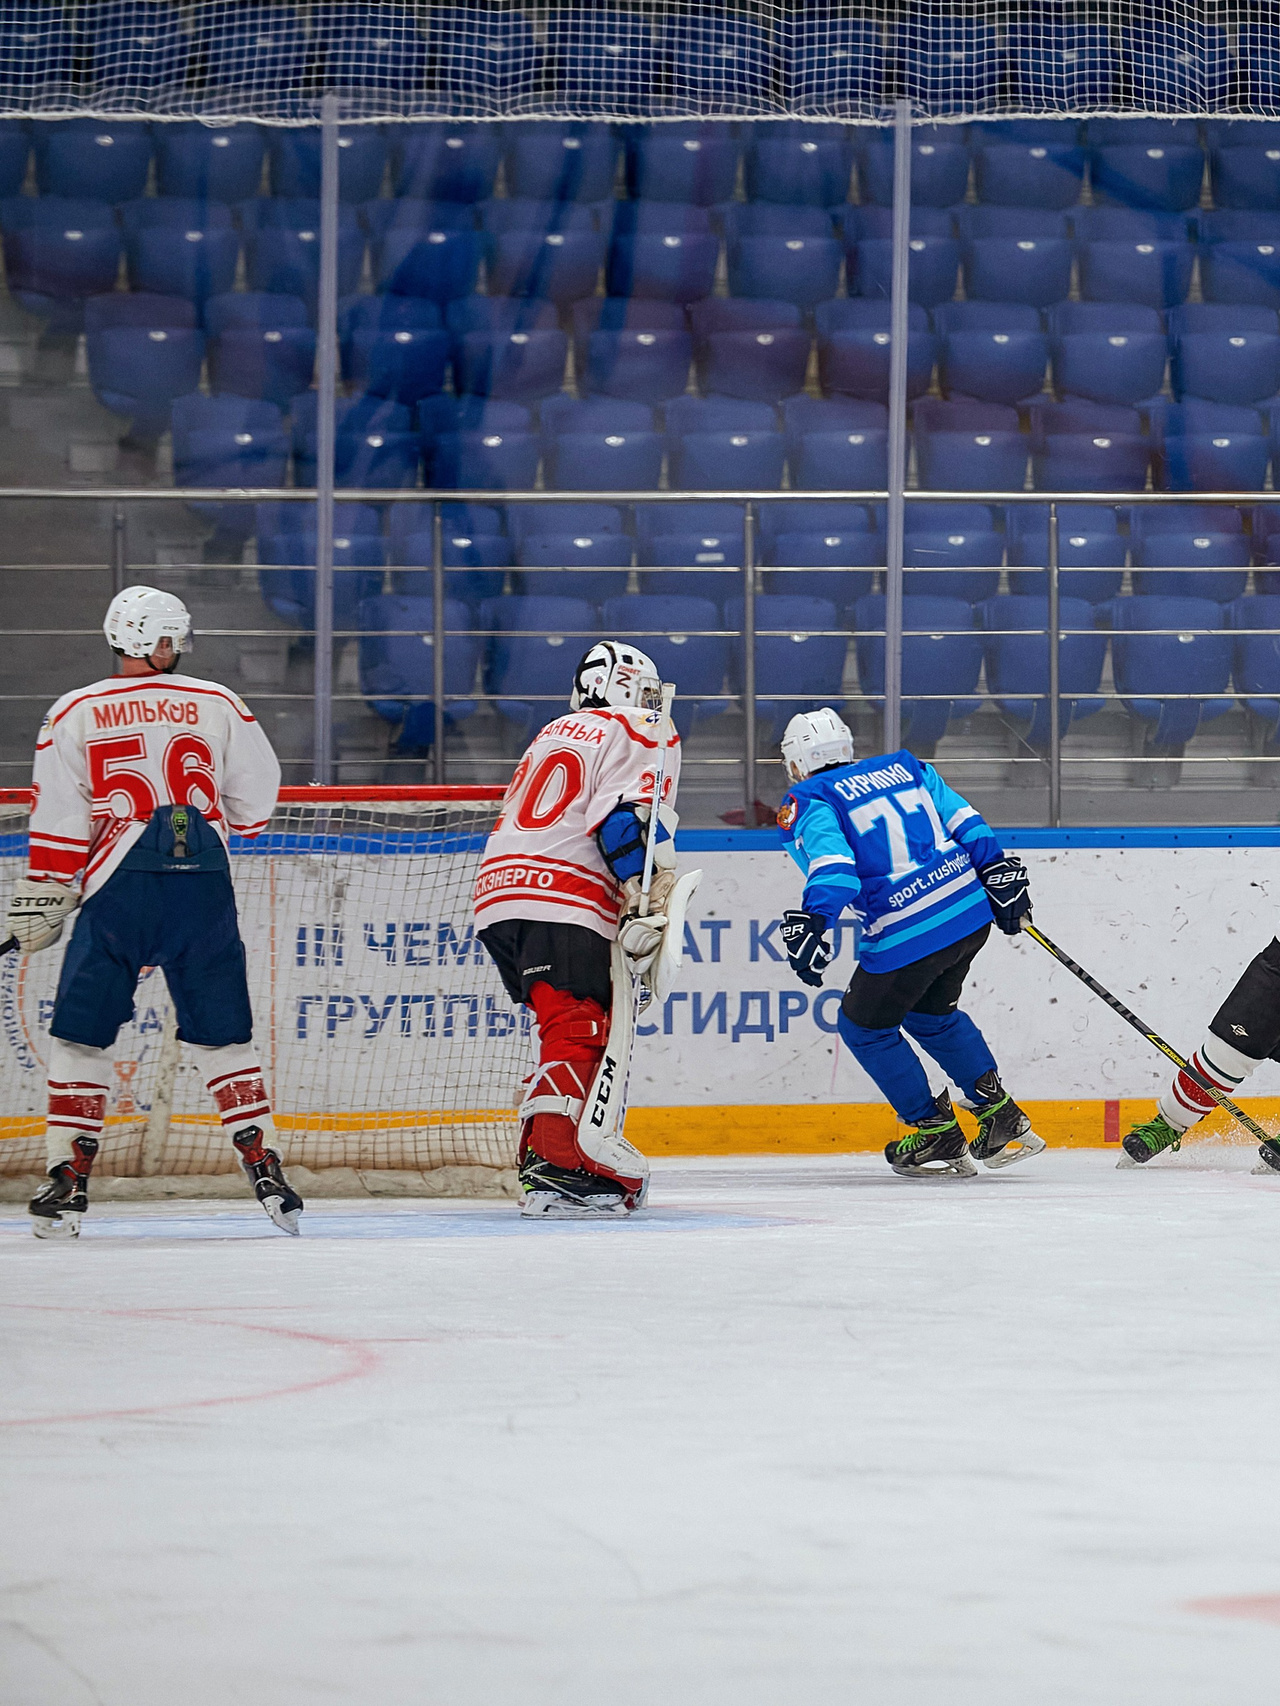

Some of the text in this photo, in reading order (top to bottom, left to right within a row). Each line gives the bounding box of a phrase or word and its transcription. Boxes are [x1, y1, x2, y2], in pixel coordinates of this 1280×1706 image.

[92, 698, 200, 730] МИЛЬКОВ
[534, 718, 607, 745] АННЫХ
[85, 732, 224, 822] 56
[833, 762, 915, 801] СКРИПКО
[848, 785, 958, 885] 77
[474, 867, 554, 900] СКЭНЕРГО
[888, 852, 971, 909] sport.rushydro
[985, 869, 1028, 887] BAU
[10, 896, 65, 908] STON
[296, 994, 531, 1039] ГРУППЫ
[590, 1054, 618, 1128] CCM
[1206, 1085, 1271, 1142] BAUER
